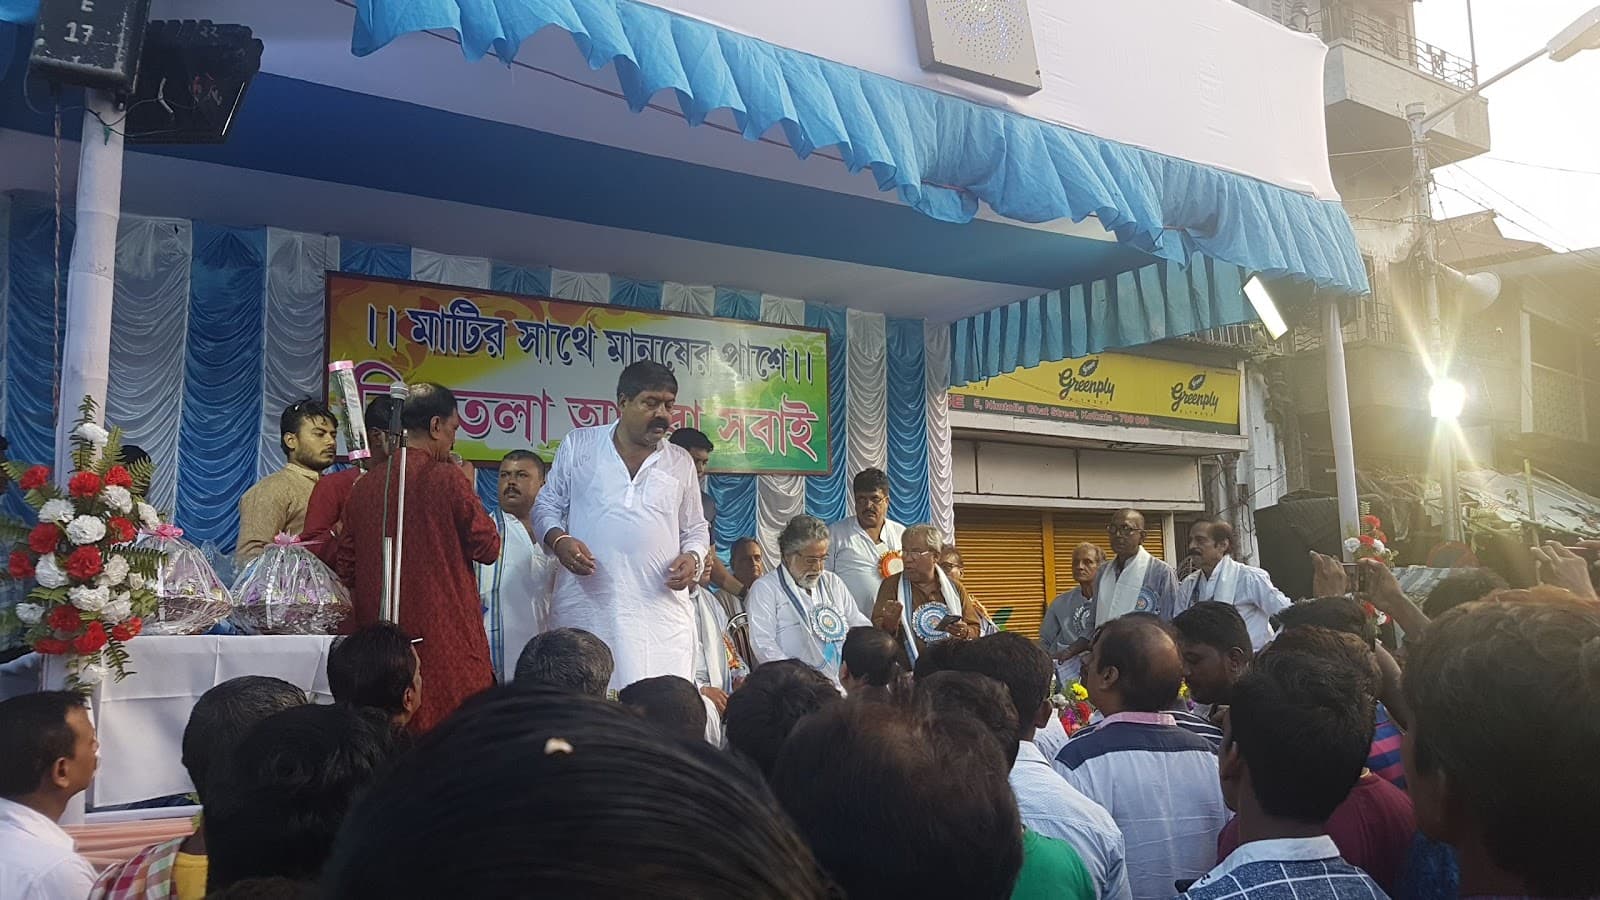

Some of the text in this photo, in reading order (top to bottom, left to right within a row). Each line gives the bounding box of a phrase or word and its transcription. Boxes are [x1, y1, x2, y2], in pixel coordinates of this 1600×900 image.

[63, 21, 95, 45] 17
[404, 297, 508, 360] মাটির
[512, 318, 598, 367] সাথে
[602, 327, 714, 377] মানষের
[1057, 367, 1116, 402] Greenply
[1170, 381, 1219, 415] Greenply
[718, 393, 819, 463] সবাই
